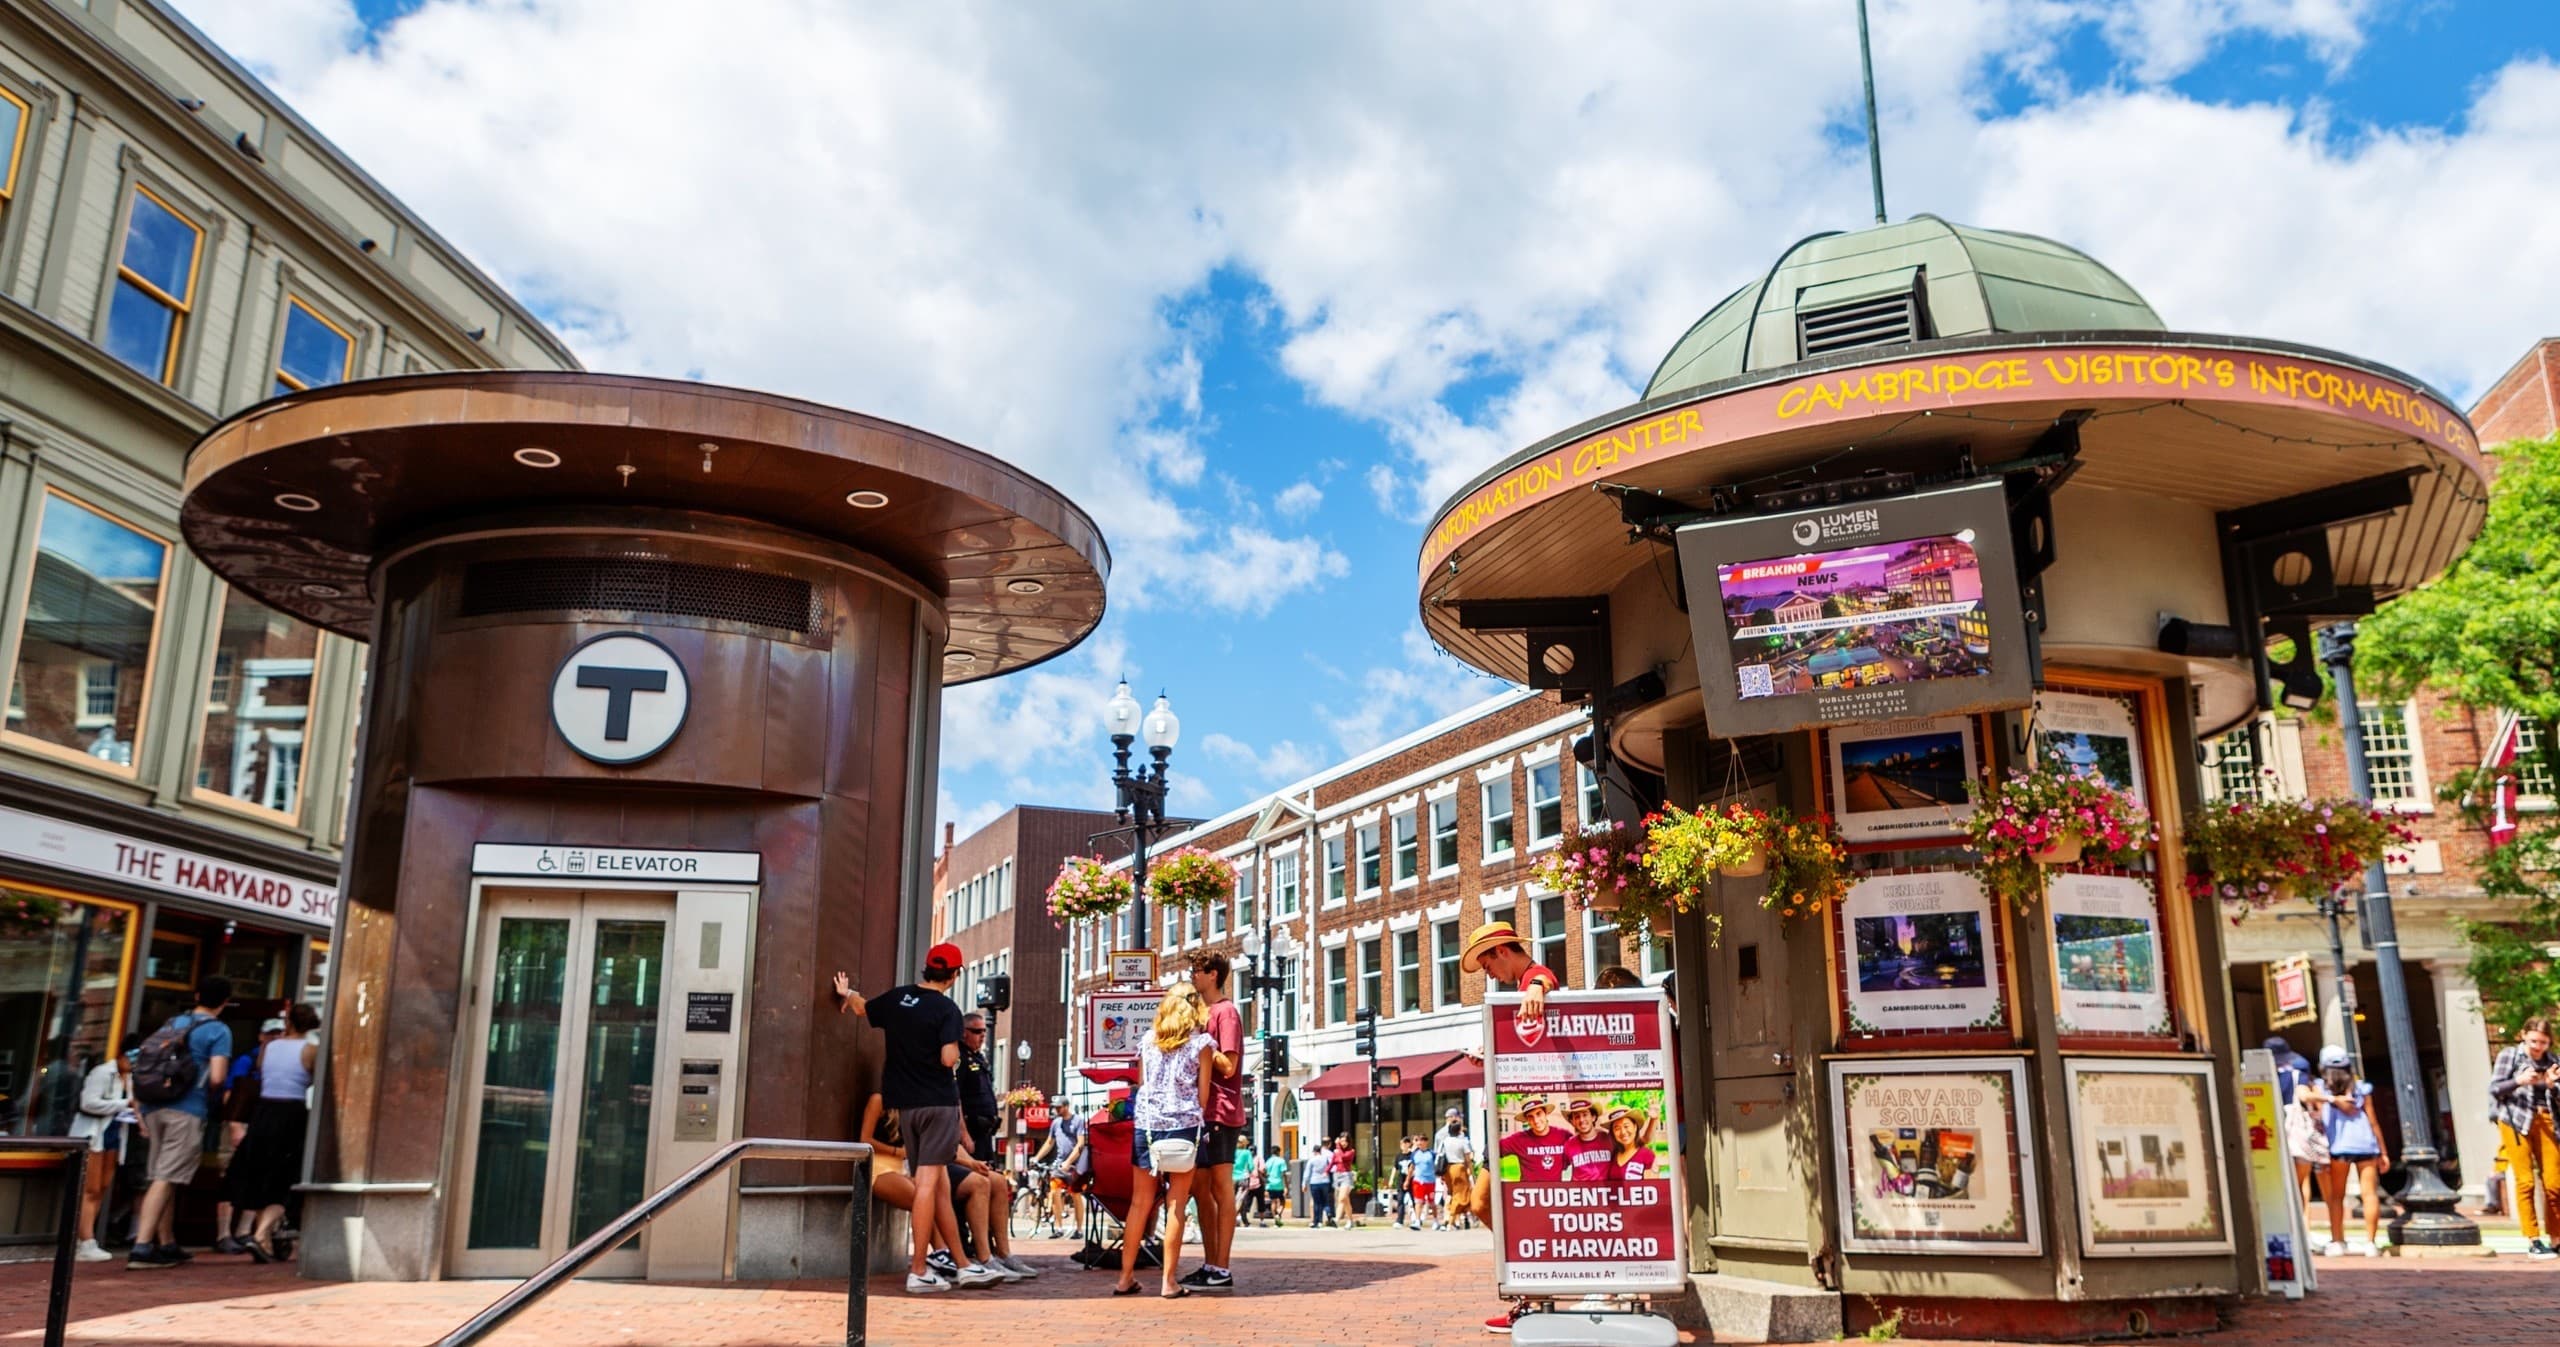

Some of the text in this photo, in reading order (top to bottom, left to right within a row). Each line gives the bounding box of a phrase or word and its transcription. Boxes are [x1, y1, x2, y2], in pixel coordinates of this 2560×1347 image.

[1776, 358, 2033, 420] CAMBRIDGE
[2043, 353, 2235, 389] VISITOR'S
[2249, 362, 2440, 434] INFORMATION
[1437, 409, 1704, 553] INFORMATION CENTER
[1820, 508, 1878, 528] LUMEN
[1822, 520, 1879, 537] ECLIPSE
[1743, 562, 1807, 580] BREAKING
[1797, 572, 1839, 587] NEWS
[577, 664, 668, 742] T
[1818, 688, 1906, 705] PUBLIC VIDEO ART
[1866, 818, 1950, 832] CAMBRIDGEUSA.ORG
[596, 855, 698, 872] ELEVATOR
[115, 843, 165, 881] THE
[175, 857, 292, 909] HARVARD
[1100, 1002, 1124, 1012] FREE
[1882, 1002, 1967, 1013] CAMBRIDGEUSA.ORG
[1608, 1033, 1636, 1046] TOUR
[1865, 1088, 1984, 1107] HARVARD
[1879, 1107, 1977, 1126] SQUARE
[1512, 1186, 1658, 1208] STUDENT-LED
[1549, 1212, 1624, 1233] TOURS
[1518, 1237, 1659, 1258] OF HARVARD
